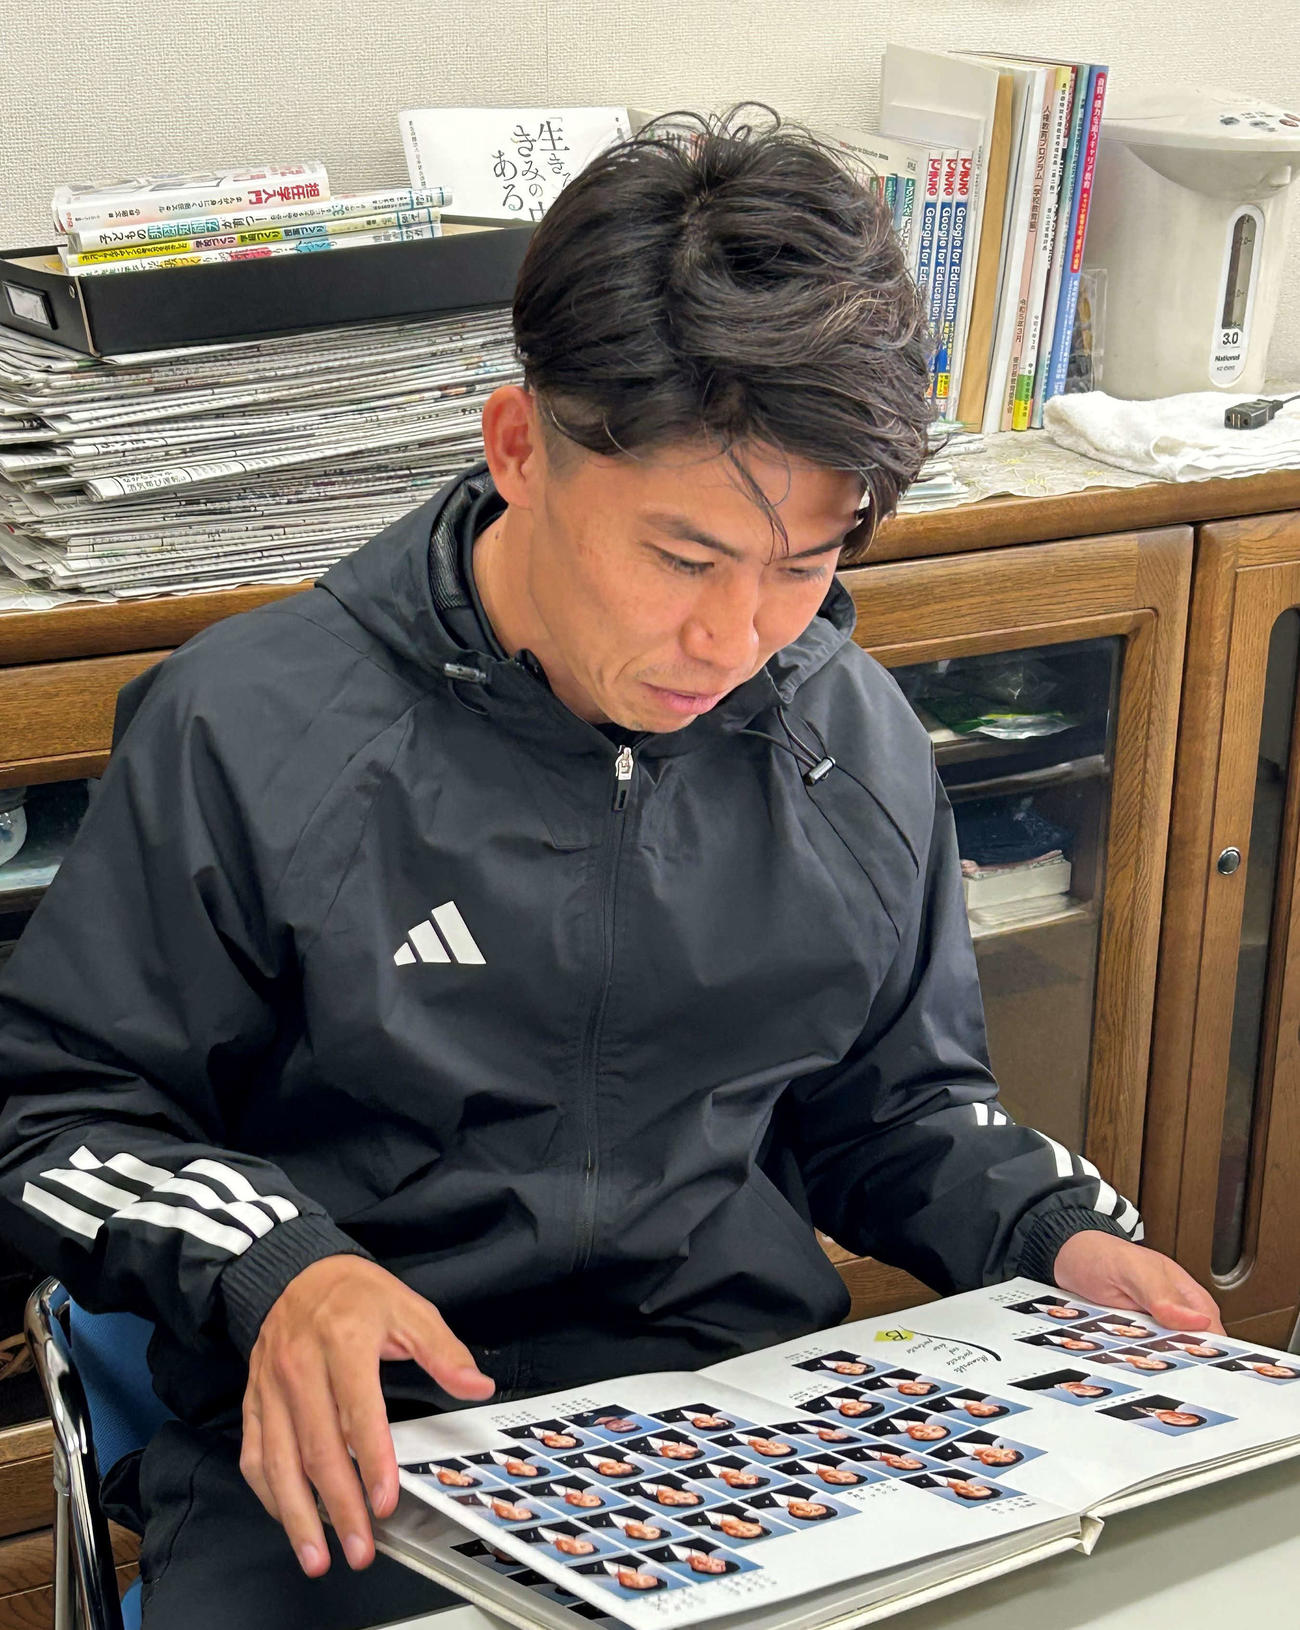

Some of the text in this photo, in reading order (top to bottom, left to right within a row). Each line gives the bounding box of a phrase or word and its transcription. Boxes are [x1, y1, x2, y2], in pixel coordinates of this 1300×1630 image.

[247, 182, 321, 206] 担任学入門
[491, 149, 524, 211] ある
[927, 158, 940, 196] できる
[943, 158, 956, 196] できる
[958, 158, 972, 196] できる
[922, 207, 935, 247] Google
[937, 207, 952, 247] Google
[952, 207, 967, 247] Google
[920, 248, 930, 264] for
[936, 248, 947, 264] for
[951, 248, 961, 264] for
[930, 266, 946, 320] Education
[945, 266, 961, 320] Education
[1222, 331, 1239, 345] 3.0
[1215, 354, 1240, 362] National
